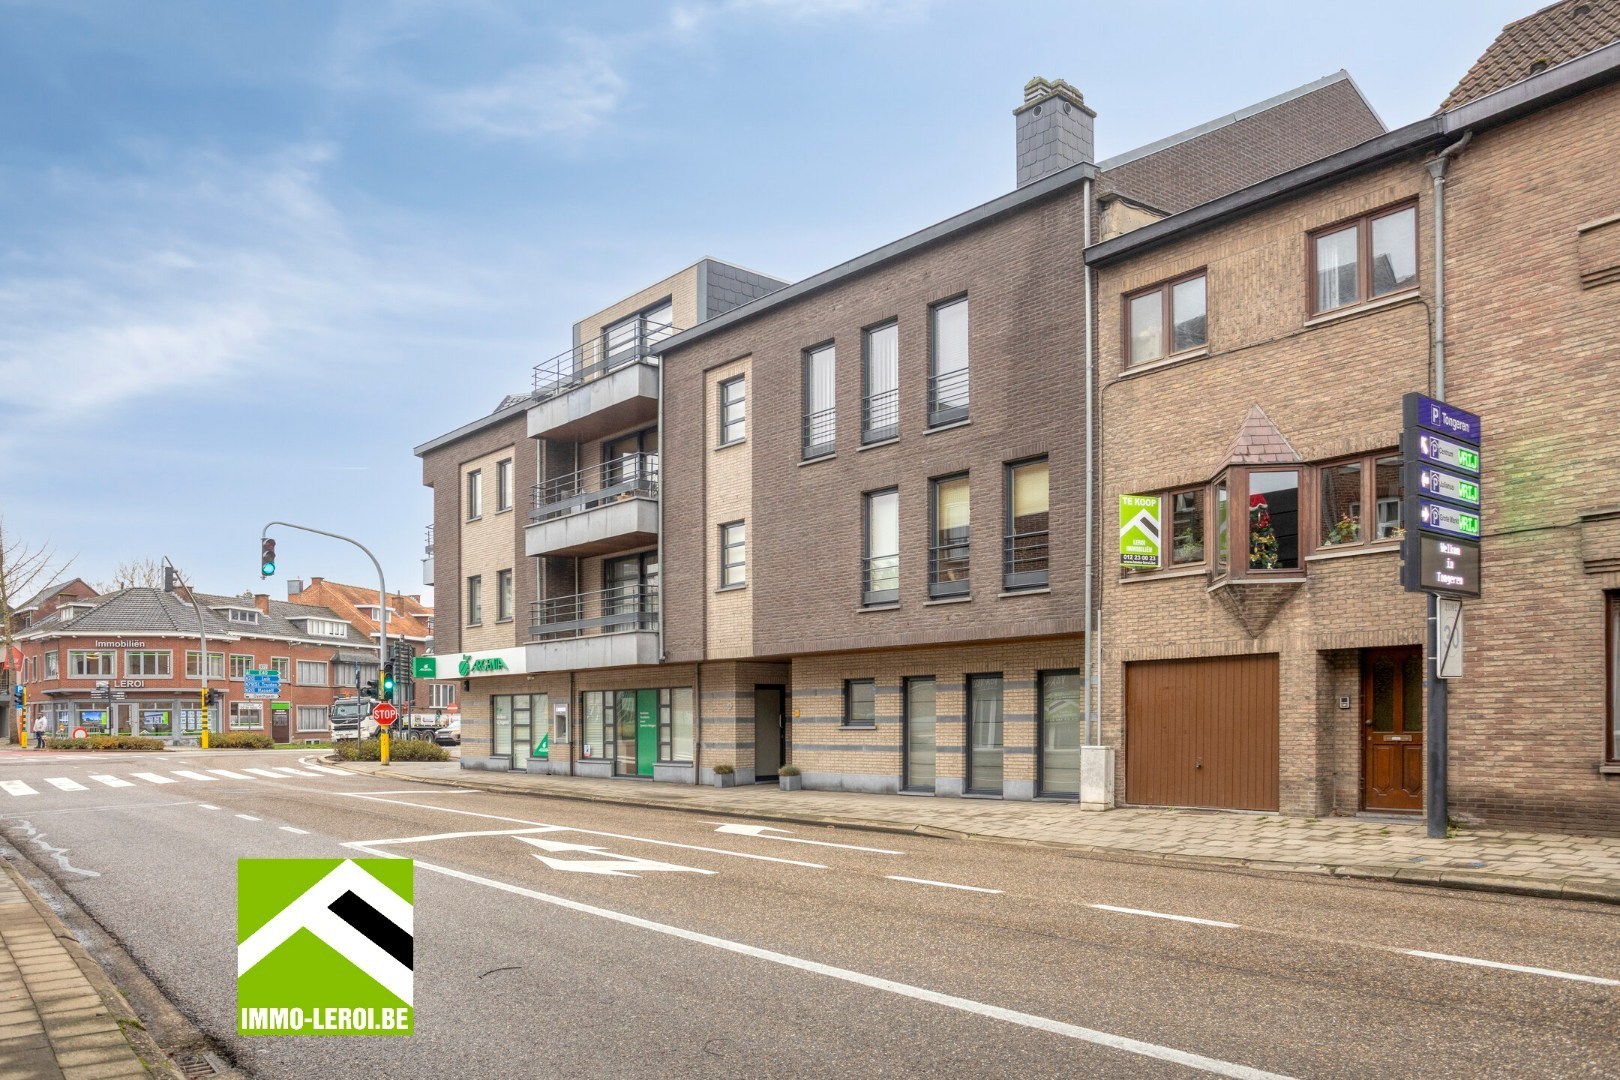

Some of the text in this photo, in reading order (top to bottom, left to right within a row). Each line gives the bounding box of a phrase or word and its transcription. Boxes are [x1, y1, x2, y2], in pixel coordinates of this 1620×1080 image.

[1442, 412, 1470, 432] Tongeren
[1439, 447, 1454, 457] Centrum
[1459, 450, 1478, 470] VRIJ
[1459, 483, 1478, 502] VRIJ
[1122, 497, 1156, 506] TE KOOP
[1459, 516, 1478, 533] VRIJ
[1440, 542, 1461, 556] Welkom
[1446, 558, 1454, 569] in
[1436, 571, 1463, 585] Tongeren
[1445, 603, 1458, 612] ZONE
[1444, 624, 1459, 649] 30
[95, 640, 145, 648] Immobiliën
[114, 680, 145, 688] LEROI
[374, 709, 396, 720] STOP
